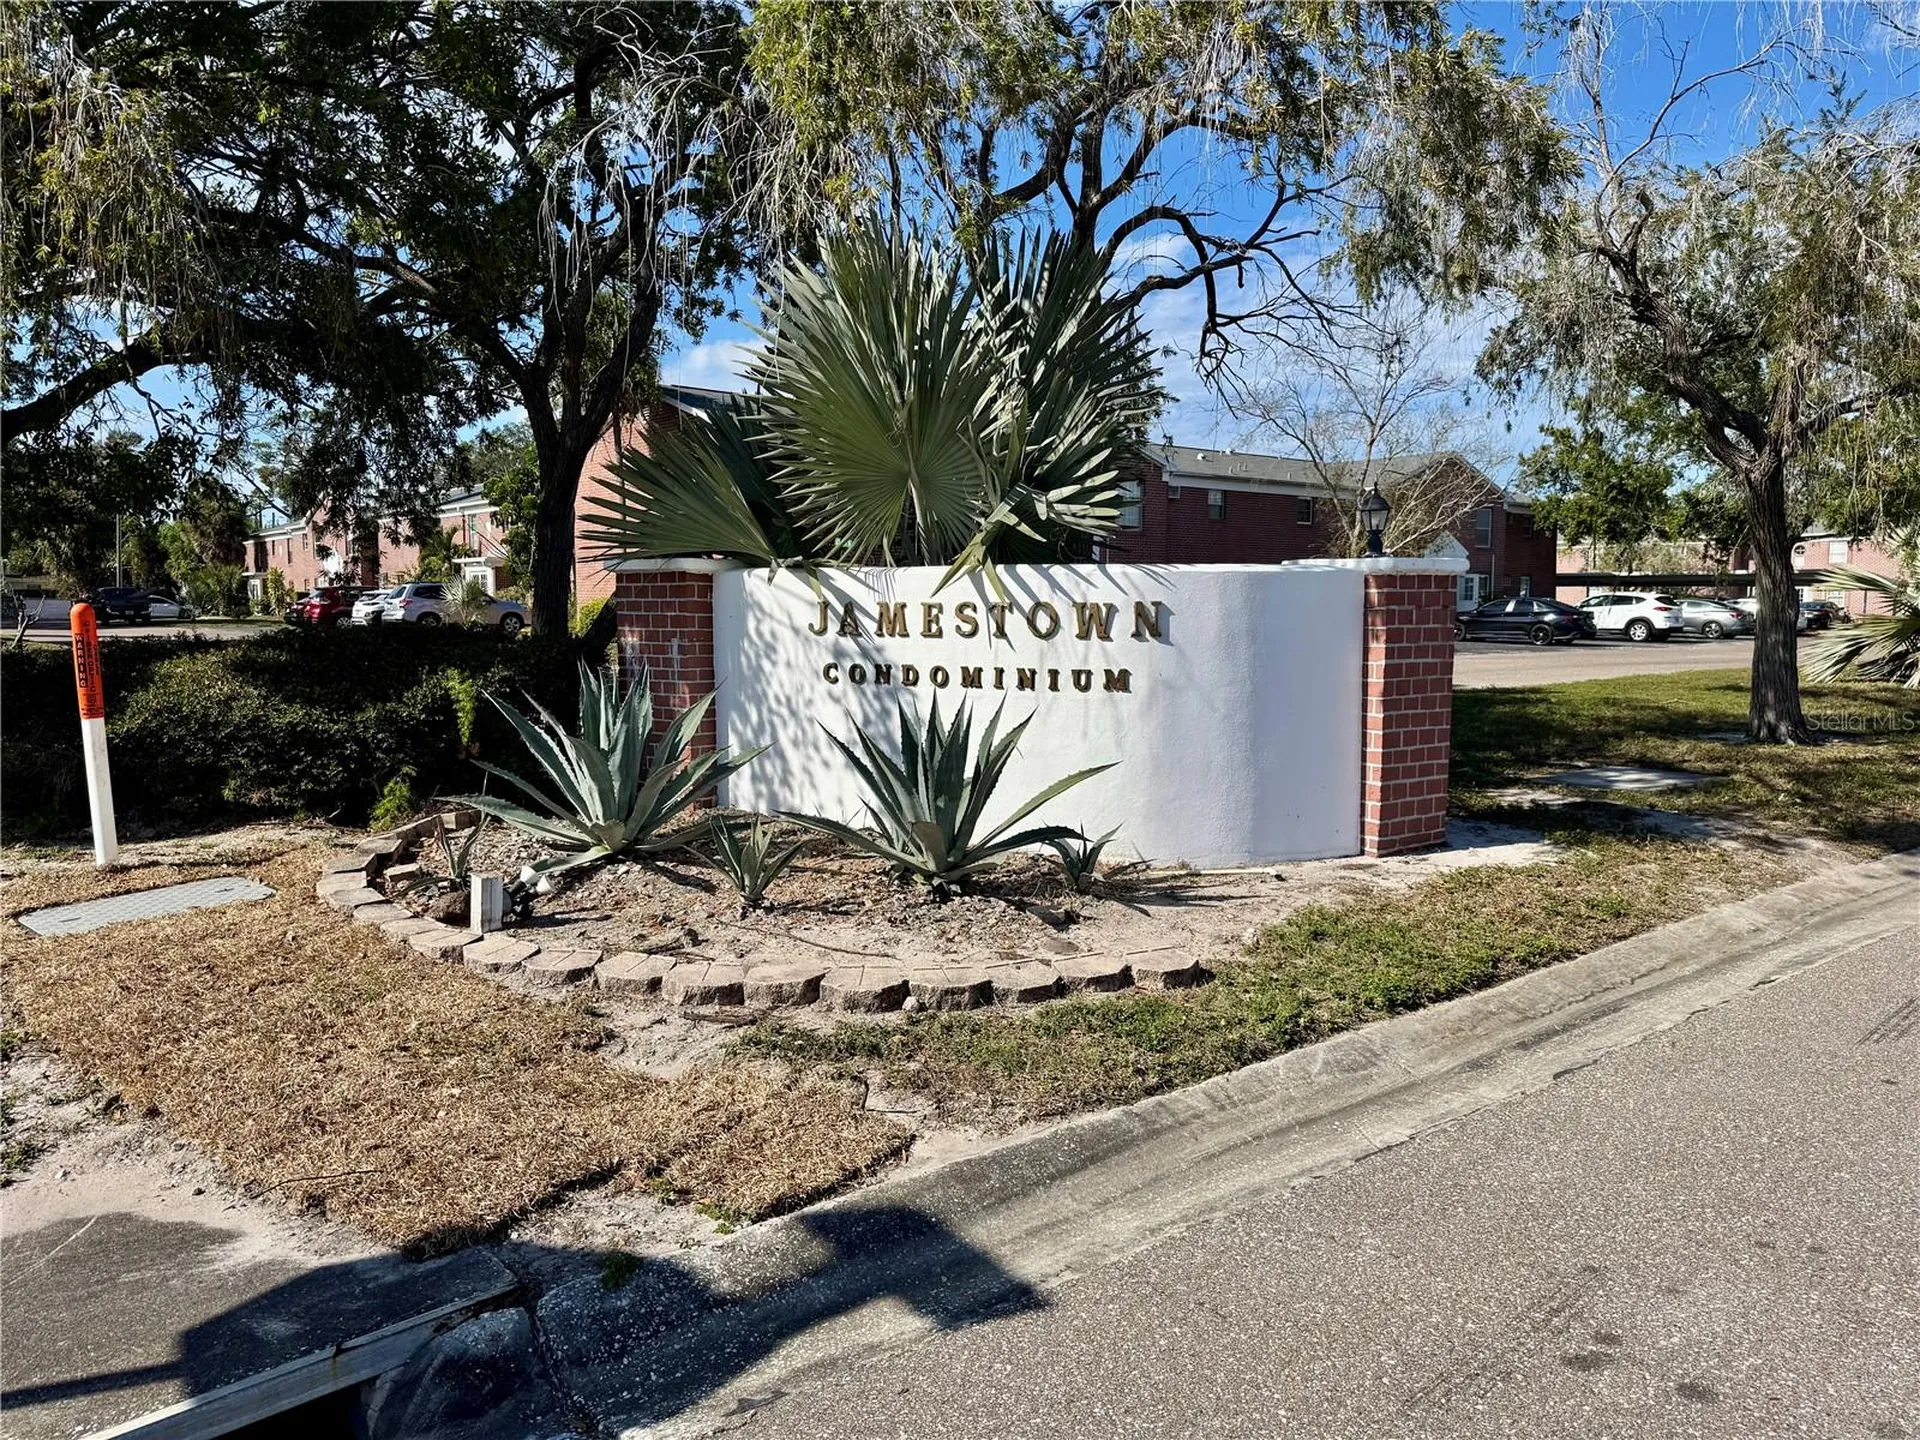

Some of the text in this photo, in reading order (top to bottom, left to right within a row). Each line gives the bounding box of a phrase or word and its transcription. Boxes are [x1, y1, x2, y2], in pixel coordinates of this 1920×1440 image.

[808, 600, 1164, 641] JAMESTOWN
[75, 634, 87, 688] WARNING
[822, 662, 1133, 693] CONDOMINIUM
